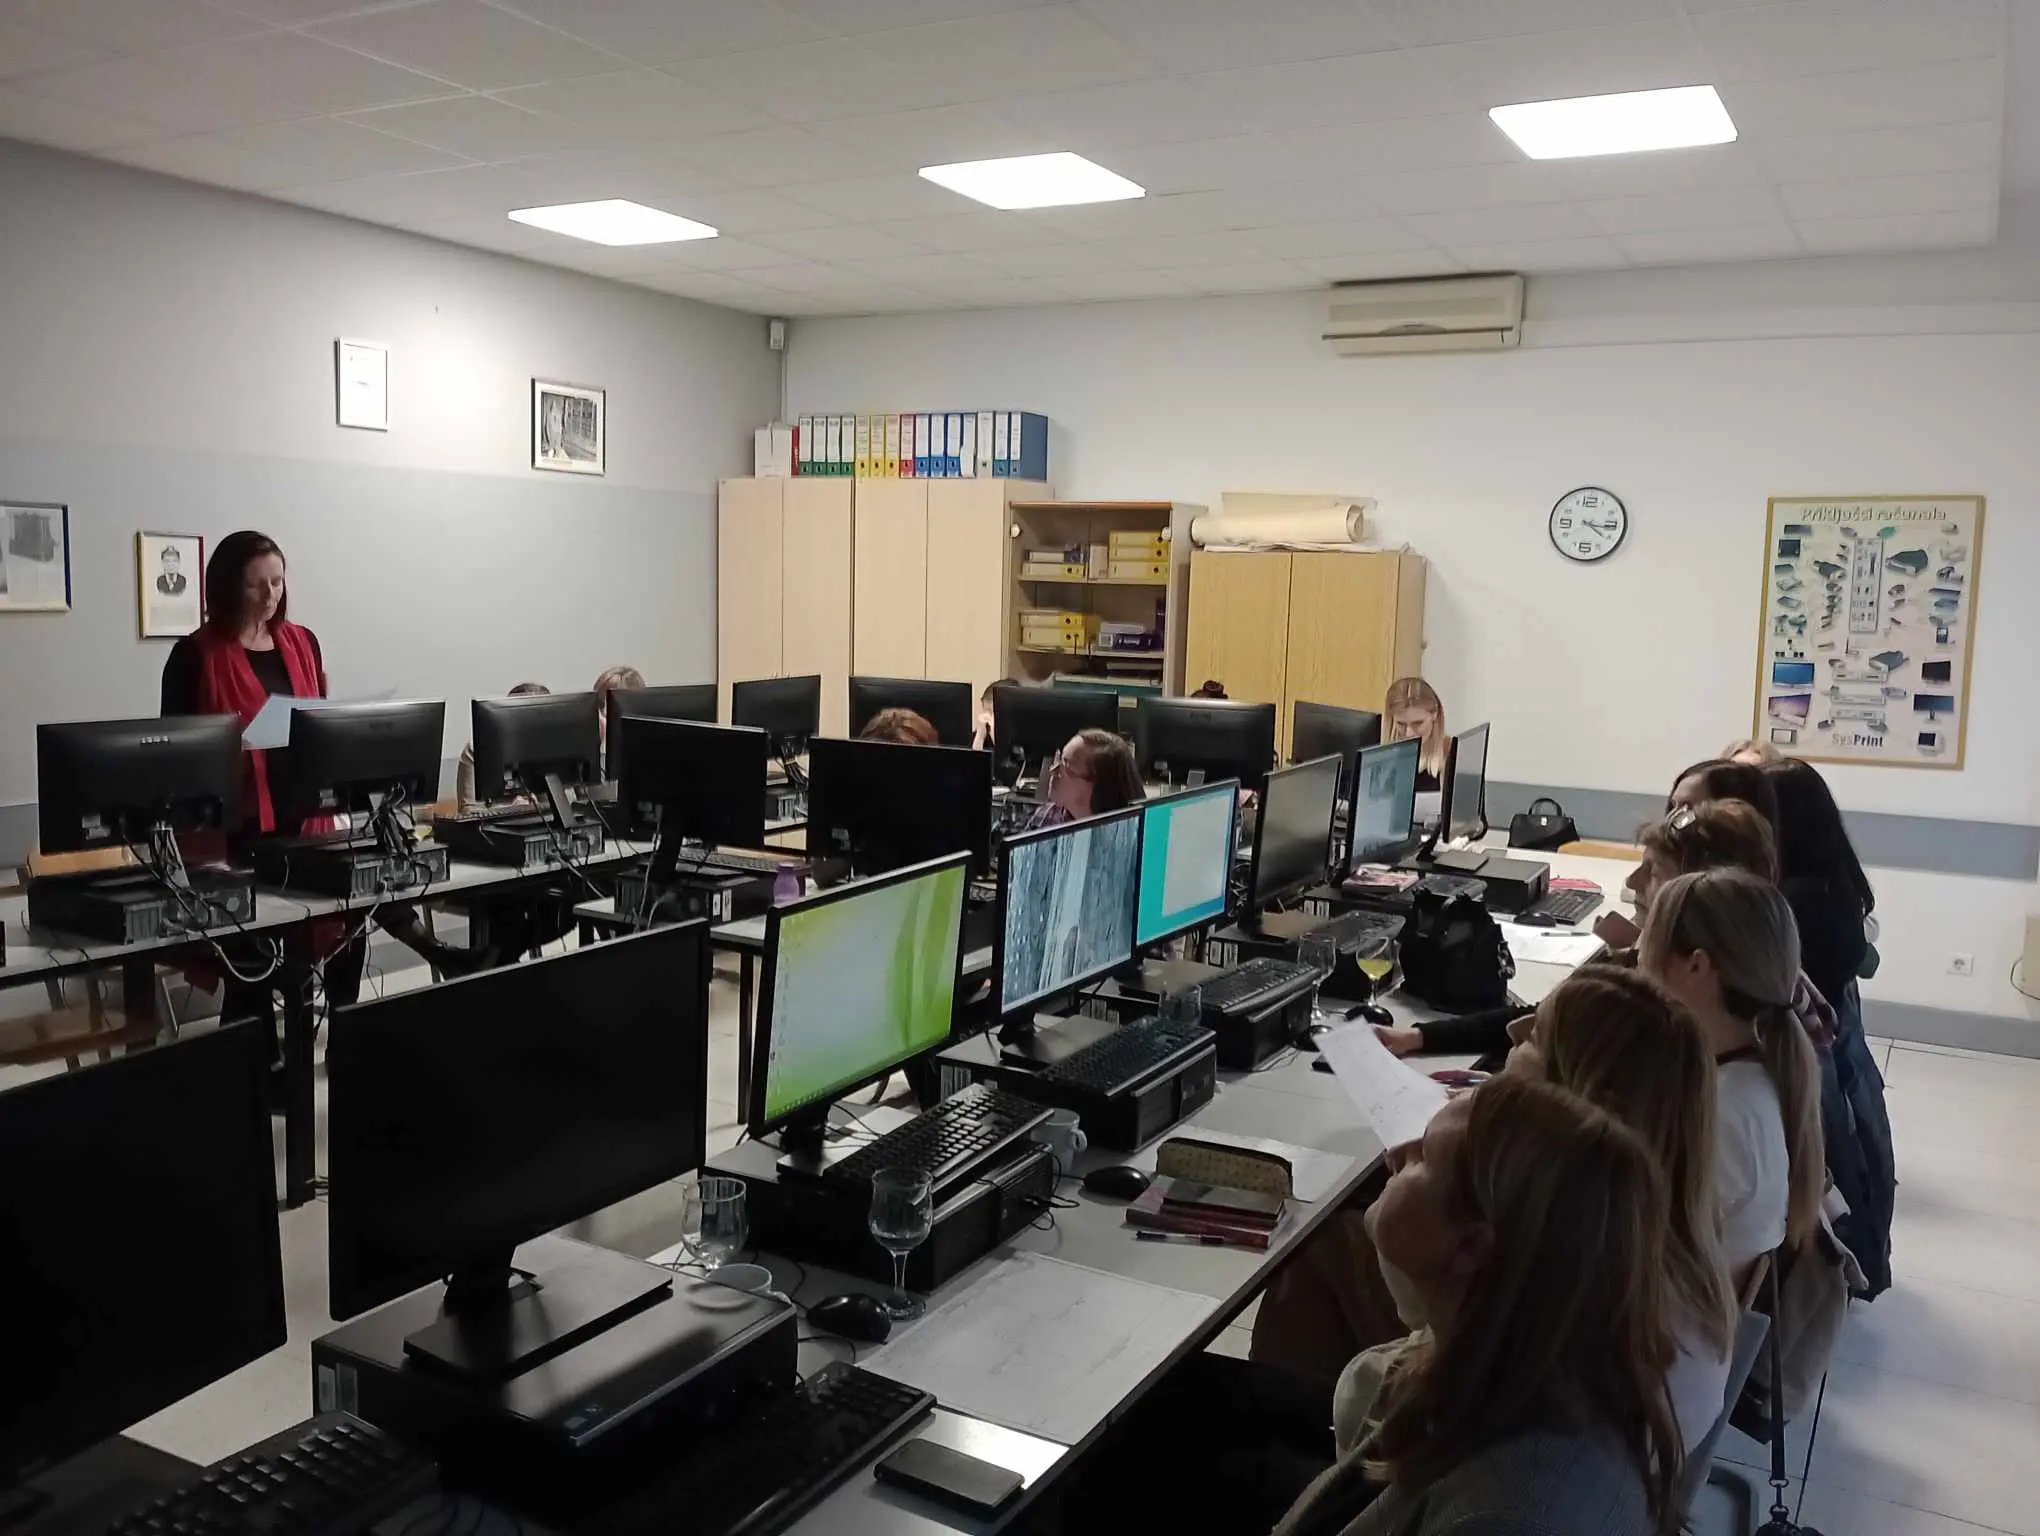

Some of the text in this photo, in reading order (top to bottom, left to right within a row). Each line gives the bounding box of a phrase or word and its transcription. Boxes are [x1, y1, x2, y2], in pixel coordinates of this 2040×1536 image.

[1559, 518, 1572, 529] 9
[1579, 542, 1592, 553] 6
[1832, 733, 1884, 748] SysPrint
